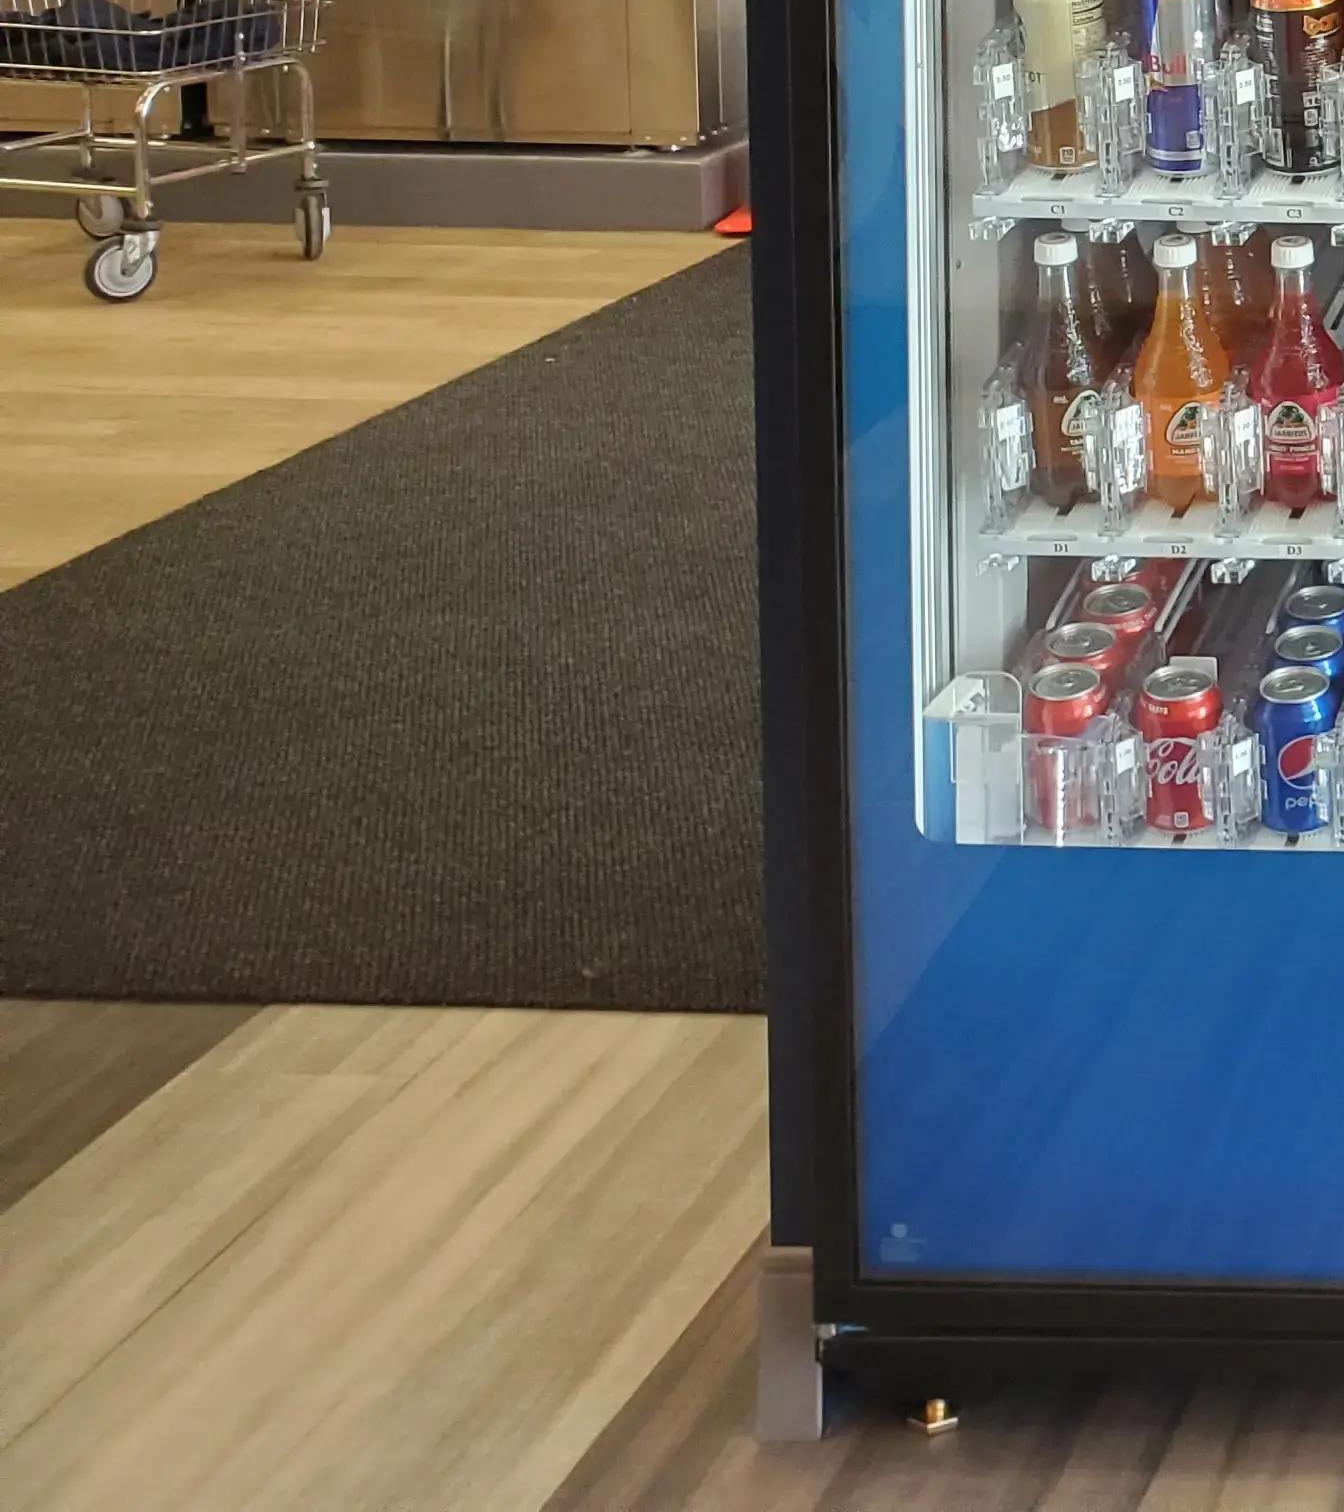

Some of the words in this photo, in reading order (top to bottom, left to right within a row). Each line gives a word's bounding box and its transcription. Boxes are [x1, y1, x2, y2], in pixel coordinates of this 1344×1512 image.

[1050, 204, 1066, 215] C1
[1168, 206, 1184, 217] C2
[1286, 208, 1303, 219] C3
[1053, 543, 1069, 554] D1
[1171, 545, 1187, 555] D2
[1286, 545, 1303, 556] D3
